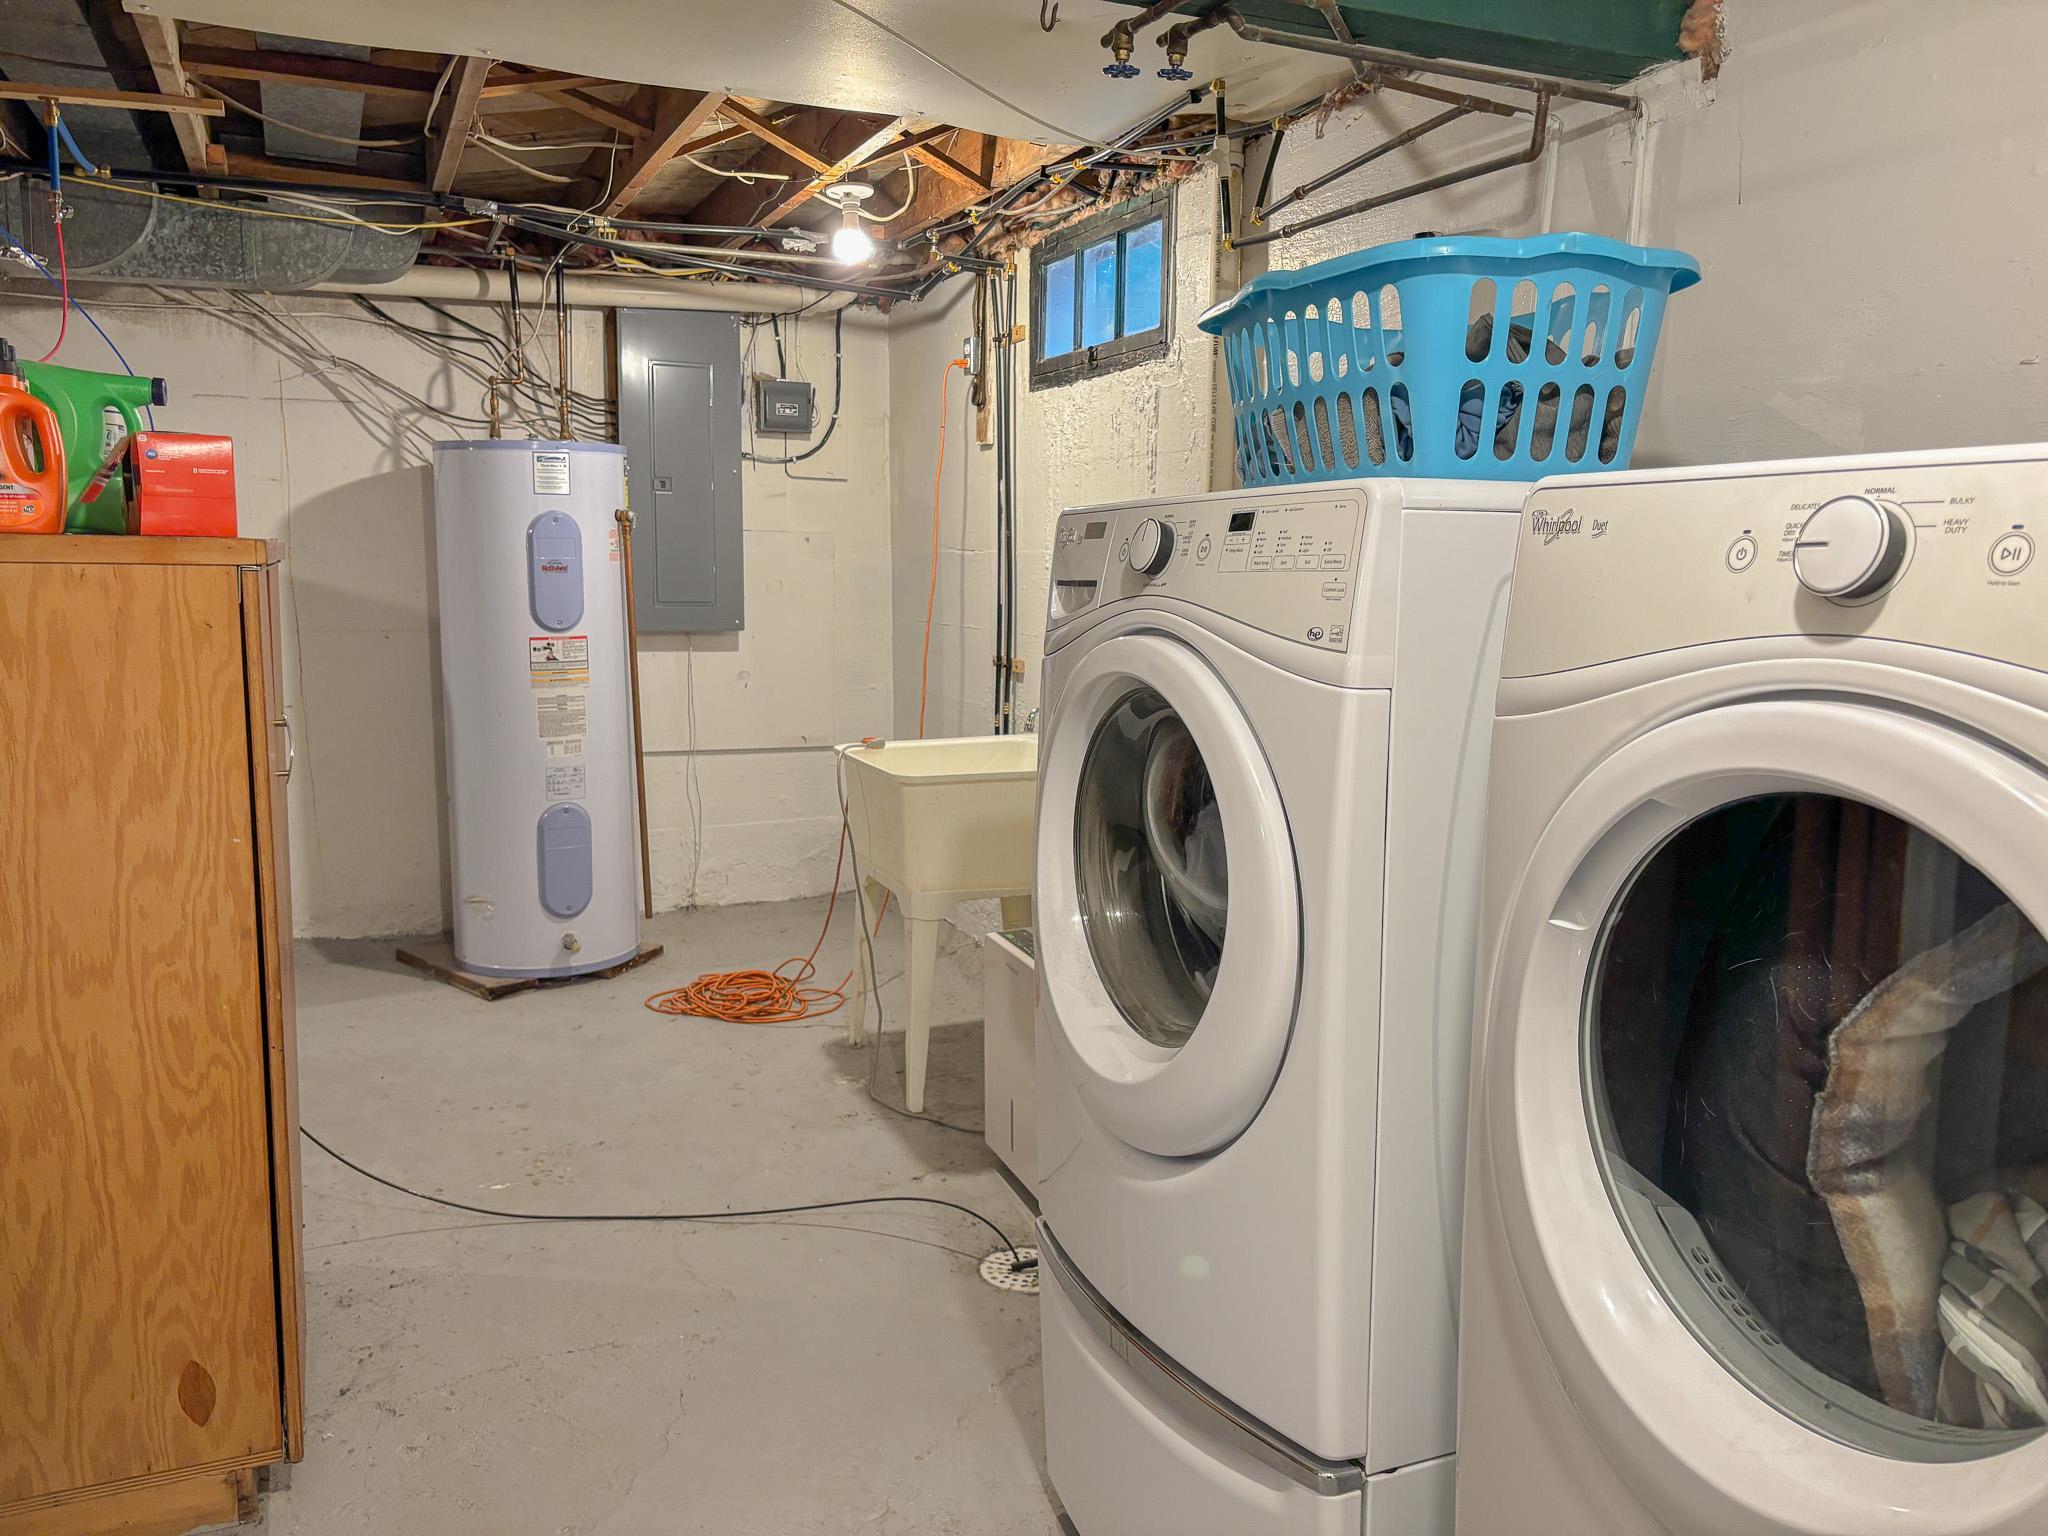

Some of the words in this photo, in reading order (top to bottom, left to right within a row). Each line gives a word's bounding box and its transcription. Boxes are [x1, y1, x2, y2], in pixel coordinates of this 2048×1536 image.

[1215, 249, 1223, 264] VENT
[1949, 497, 1975, 505] BULKY
[1943, 518, 1969, 526] HEAVY
[1531, 509, 1583, 546] Whirlpool
[1591, 518, 1609, 532] Duet
[1945, 526, 1967, 534] DUTY
